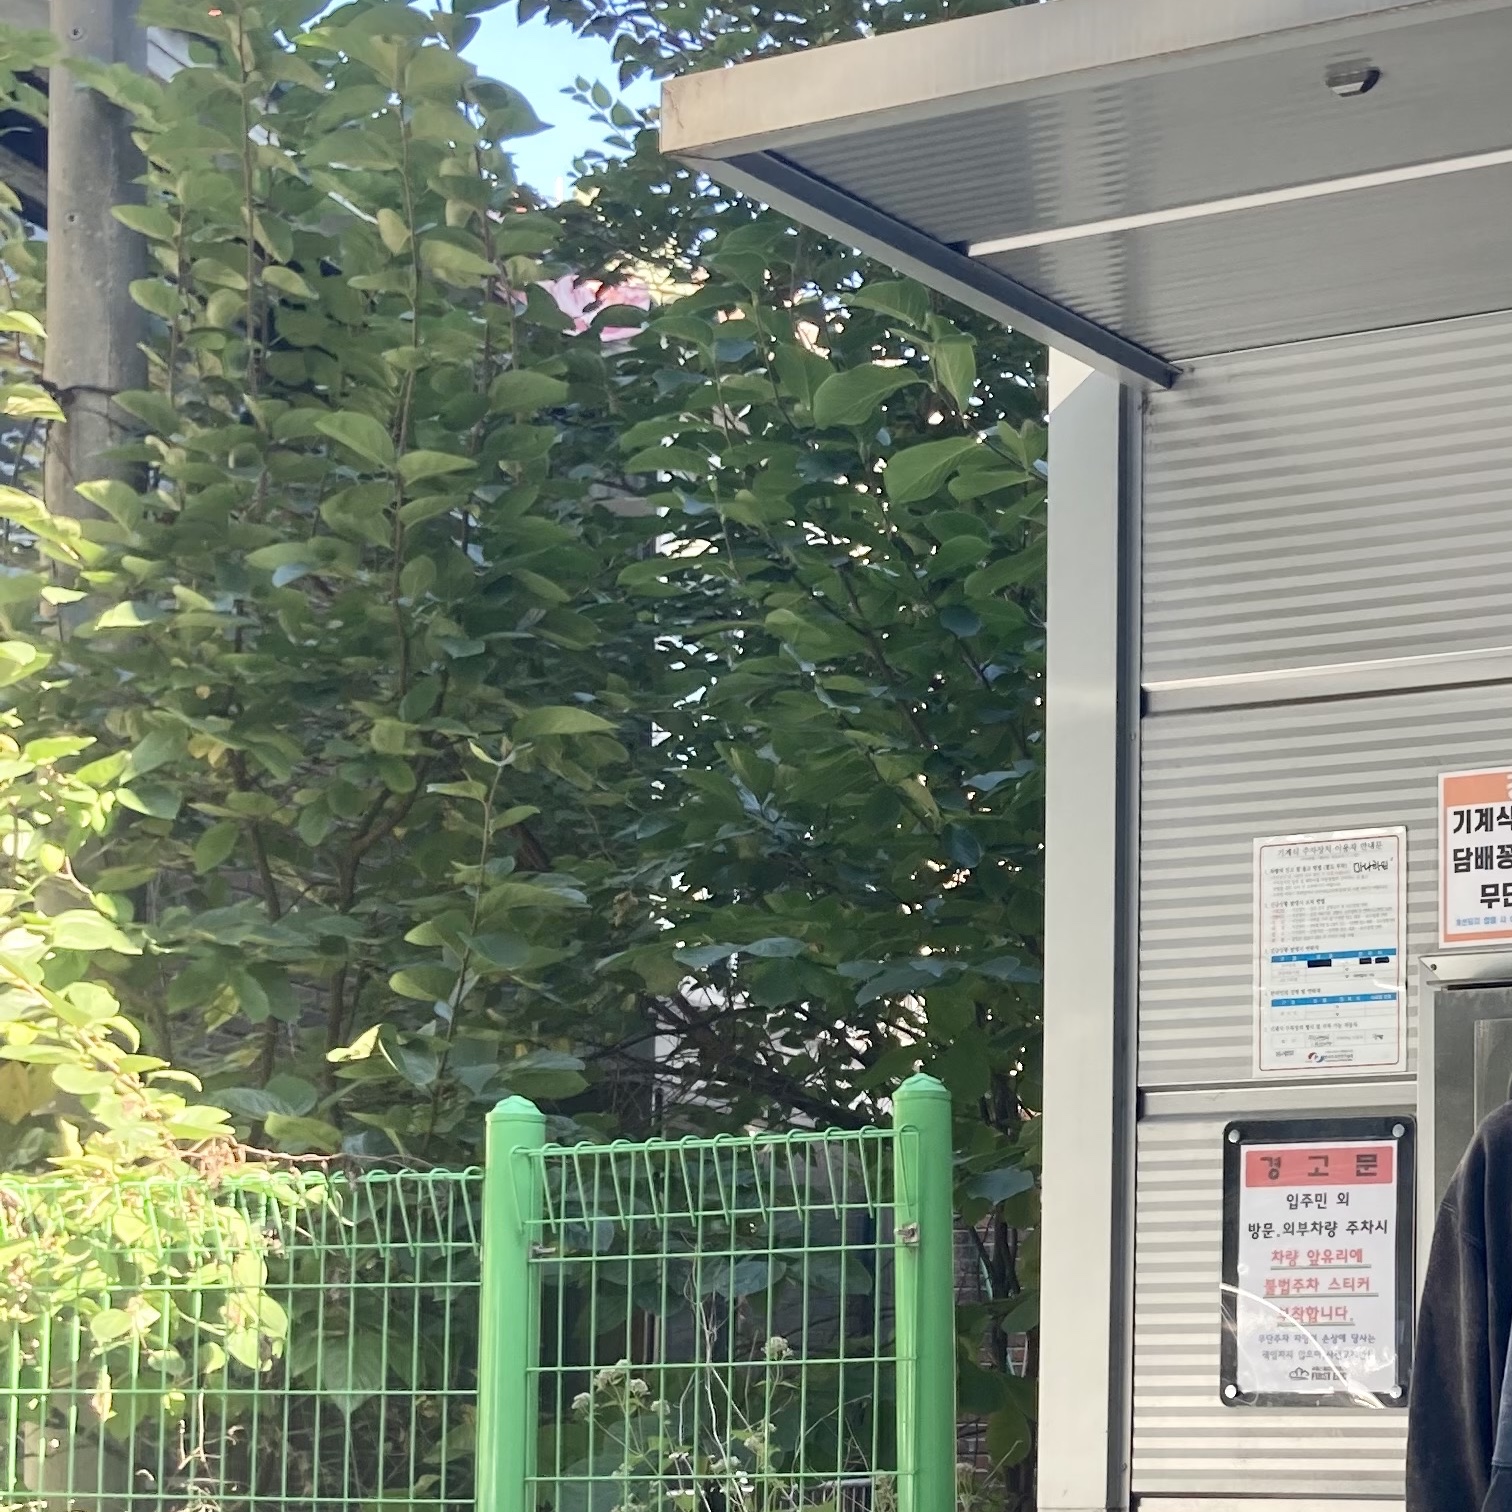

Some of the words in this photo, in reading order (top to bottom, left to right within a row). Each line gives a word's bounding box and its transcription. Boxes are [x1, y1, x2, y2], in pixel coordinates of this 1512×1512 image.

[1286, 1192, 1328, 1210] 입주민
[1337, 1192, 1350, 1206] 외
[1346, 1219, 1388, 1235] 주차시
[1271, 1250, 1299, 1266] 차량
[1307, 1249, 1363, 1266] 앞유리에
[1264, 1278, 1320, 1296] 불법주차
[1329, 1277, 1370, 1291] 스티커
